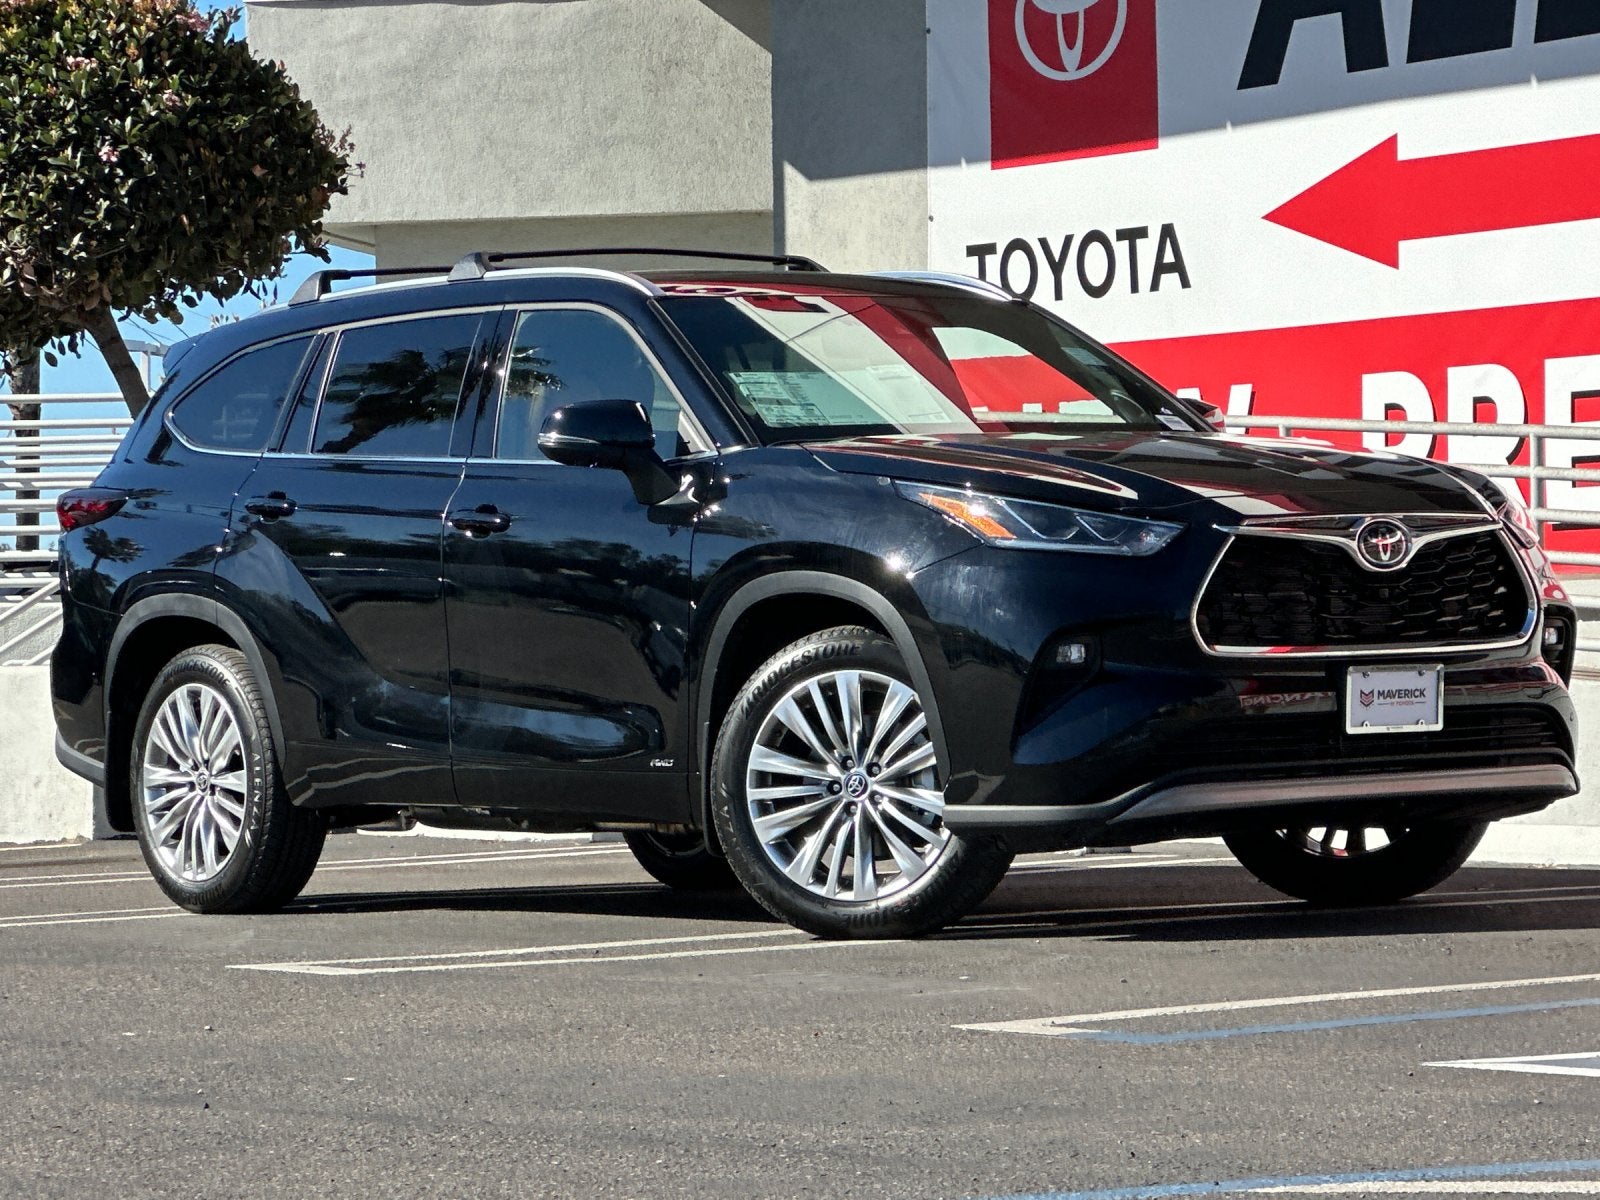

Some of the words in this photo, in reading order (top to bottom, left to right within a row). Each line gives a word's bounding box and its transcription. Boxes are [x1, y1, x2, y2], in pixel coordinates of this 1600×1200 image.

[966, 222, 1192, 301] TOYOTA
[1377, 687, 1426, 700] MAVERICK
[250, 752, 262, 830] ALENZA
